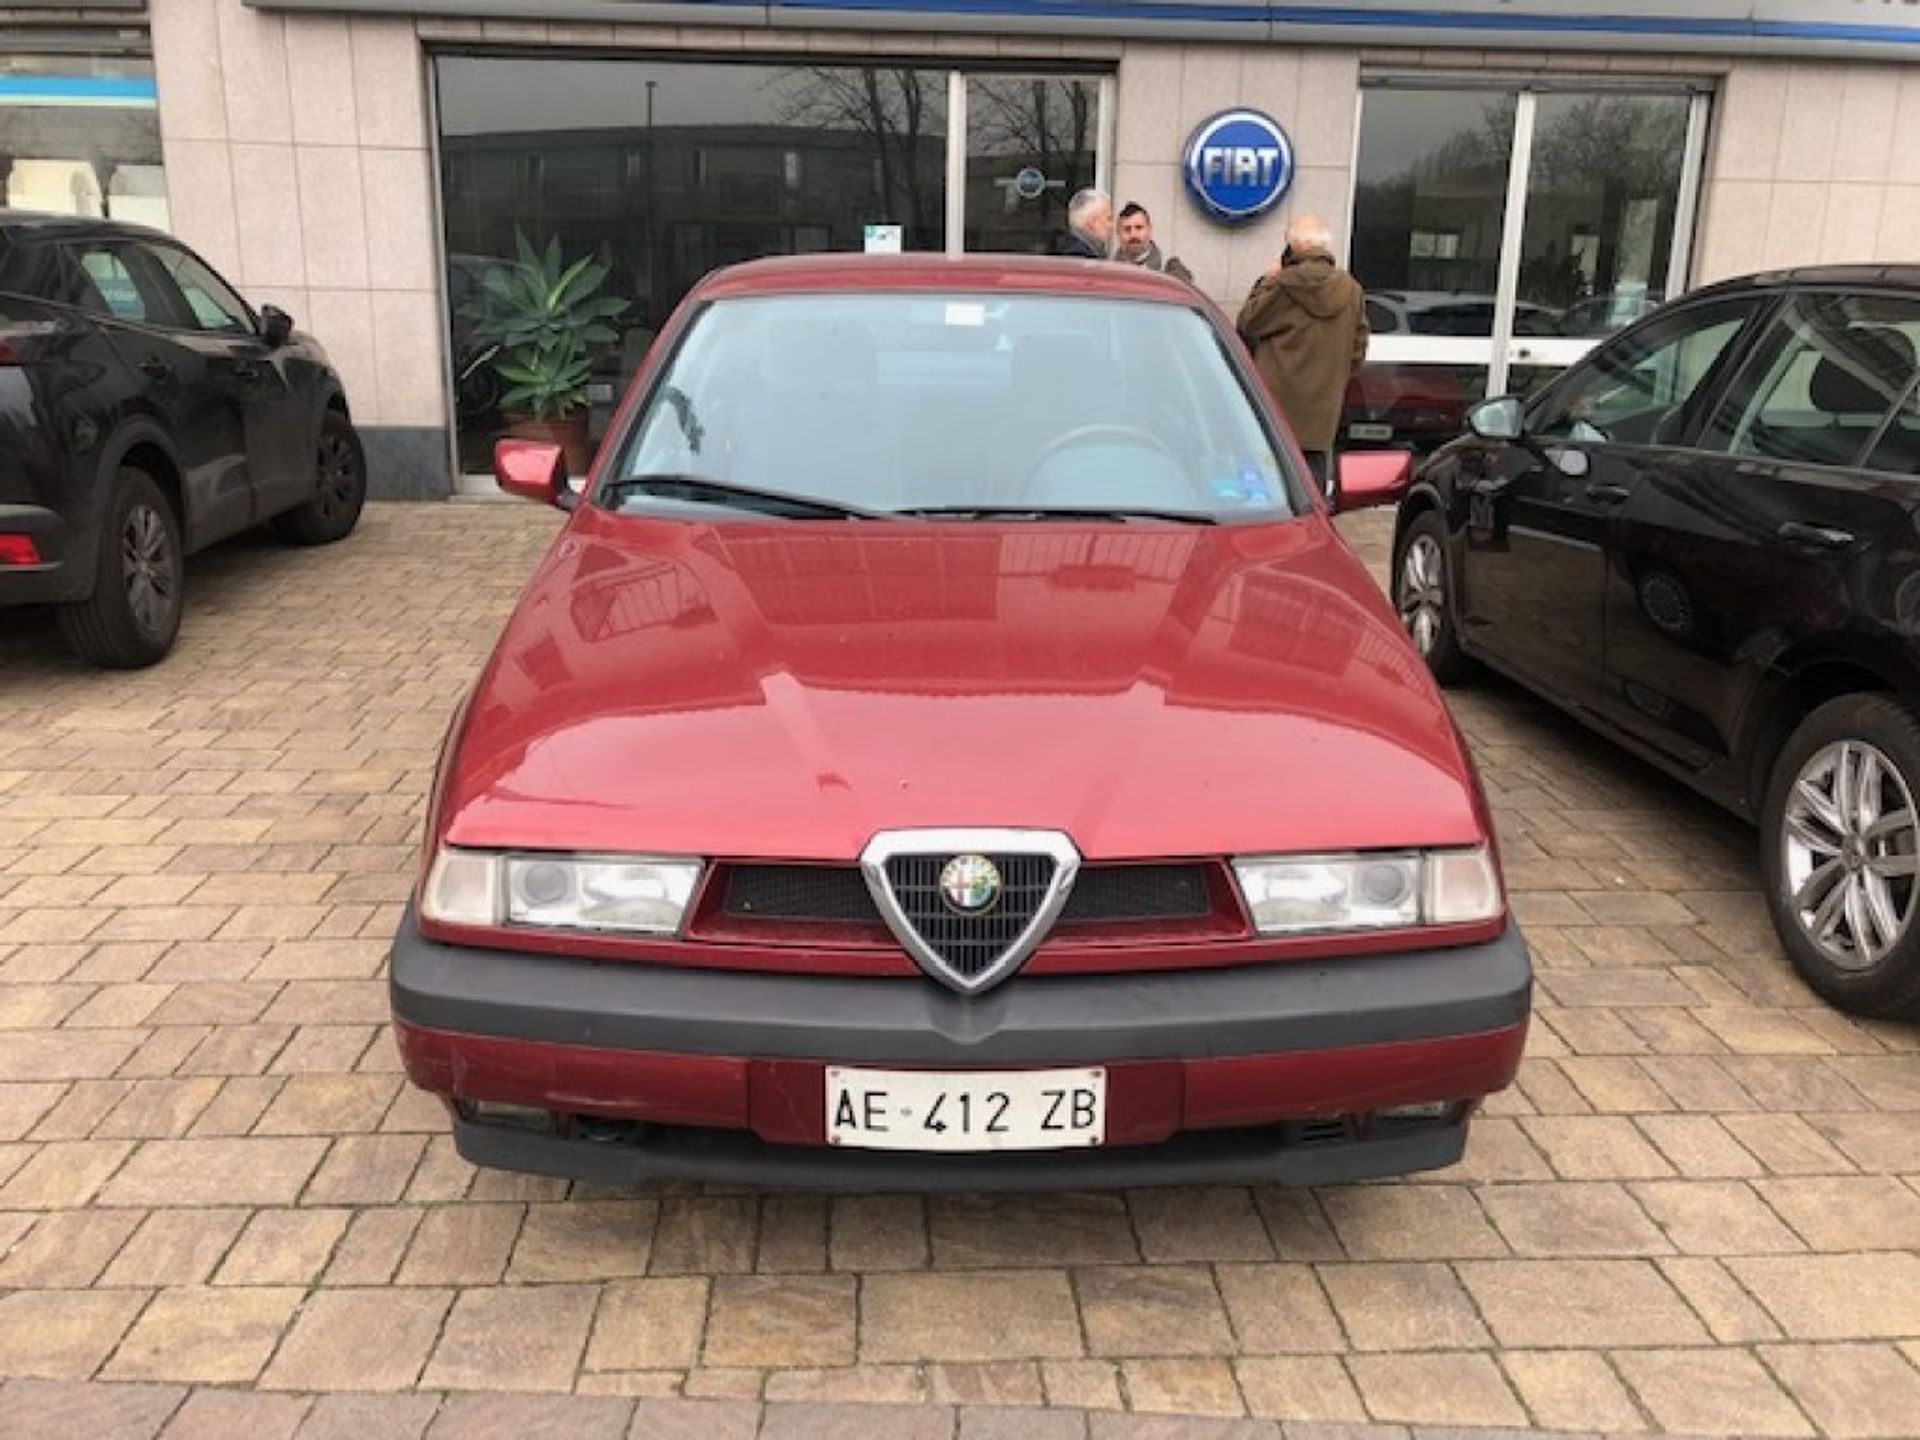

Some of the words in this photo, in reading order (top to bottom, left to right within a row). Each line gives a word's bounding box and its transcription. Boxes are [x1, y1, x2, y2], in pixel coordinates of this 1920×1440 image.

[1204, 146, 1279, 187] FIAT
[834, 1088, 889, 1132] AE
[923, 1091, 1010, 1133] 412
[1040, 1088, 1096, 1131] ZB
